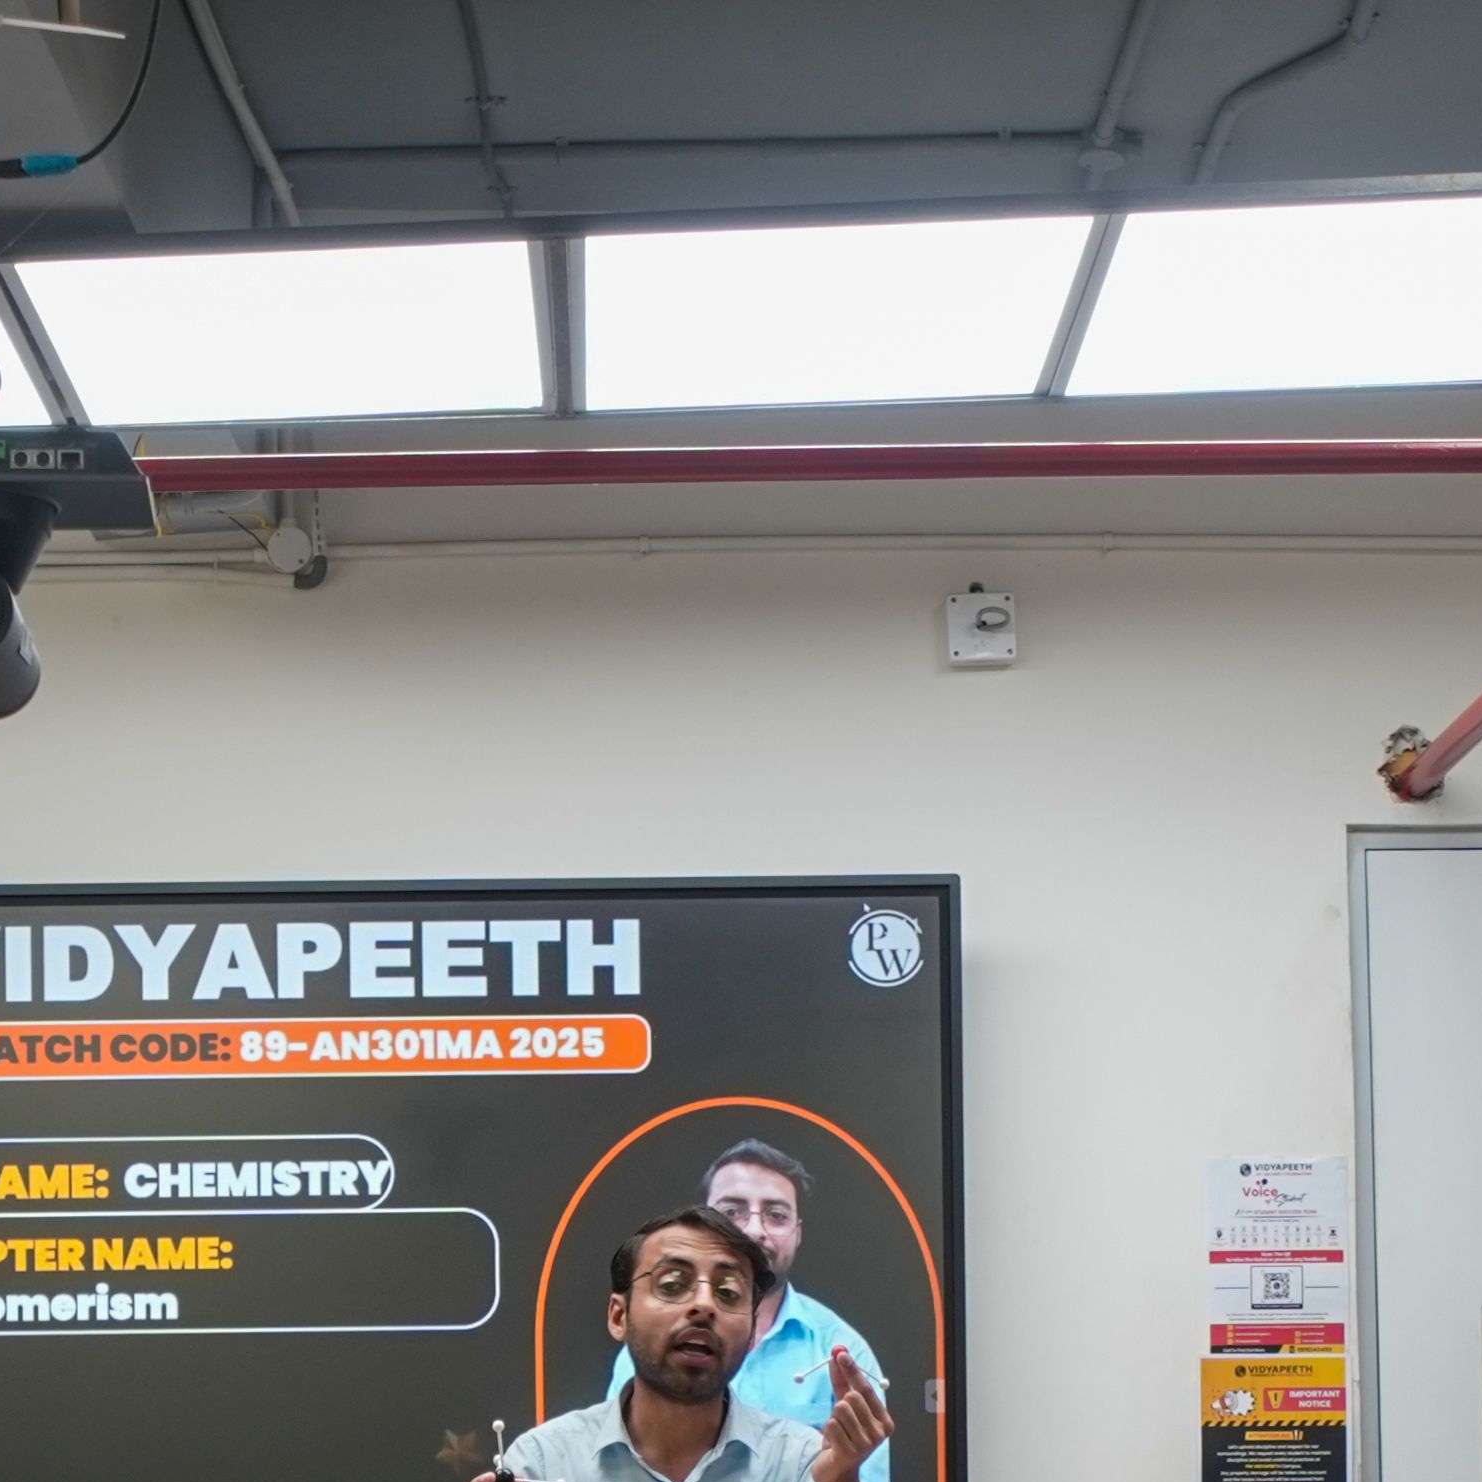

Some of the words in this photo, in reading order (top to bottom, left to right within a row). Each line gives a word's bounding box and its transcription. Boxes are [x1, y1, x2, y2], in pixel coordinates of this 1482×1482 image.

[110, 1033, 231, 1062] CODE:
[240, 1029, 502, 1061] 89-AN301MA
[510, 1028, 604, 1058] 2025
[1254, 1163, 1312, 1171] VIDYAPEETH
[124, 1160, 390, 1199] CHEMISTRY
[1242, 1186, 1278, 1197] Voice
[93, 1237, 233, 1270] NAME:
[1248, 1365, 1313, 1374] VIDYAPEETH
[1289, 1390, 1340, 1398] IMPORTANT
[1298, 1400, 1331, 1408] NOTICE
